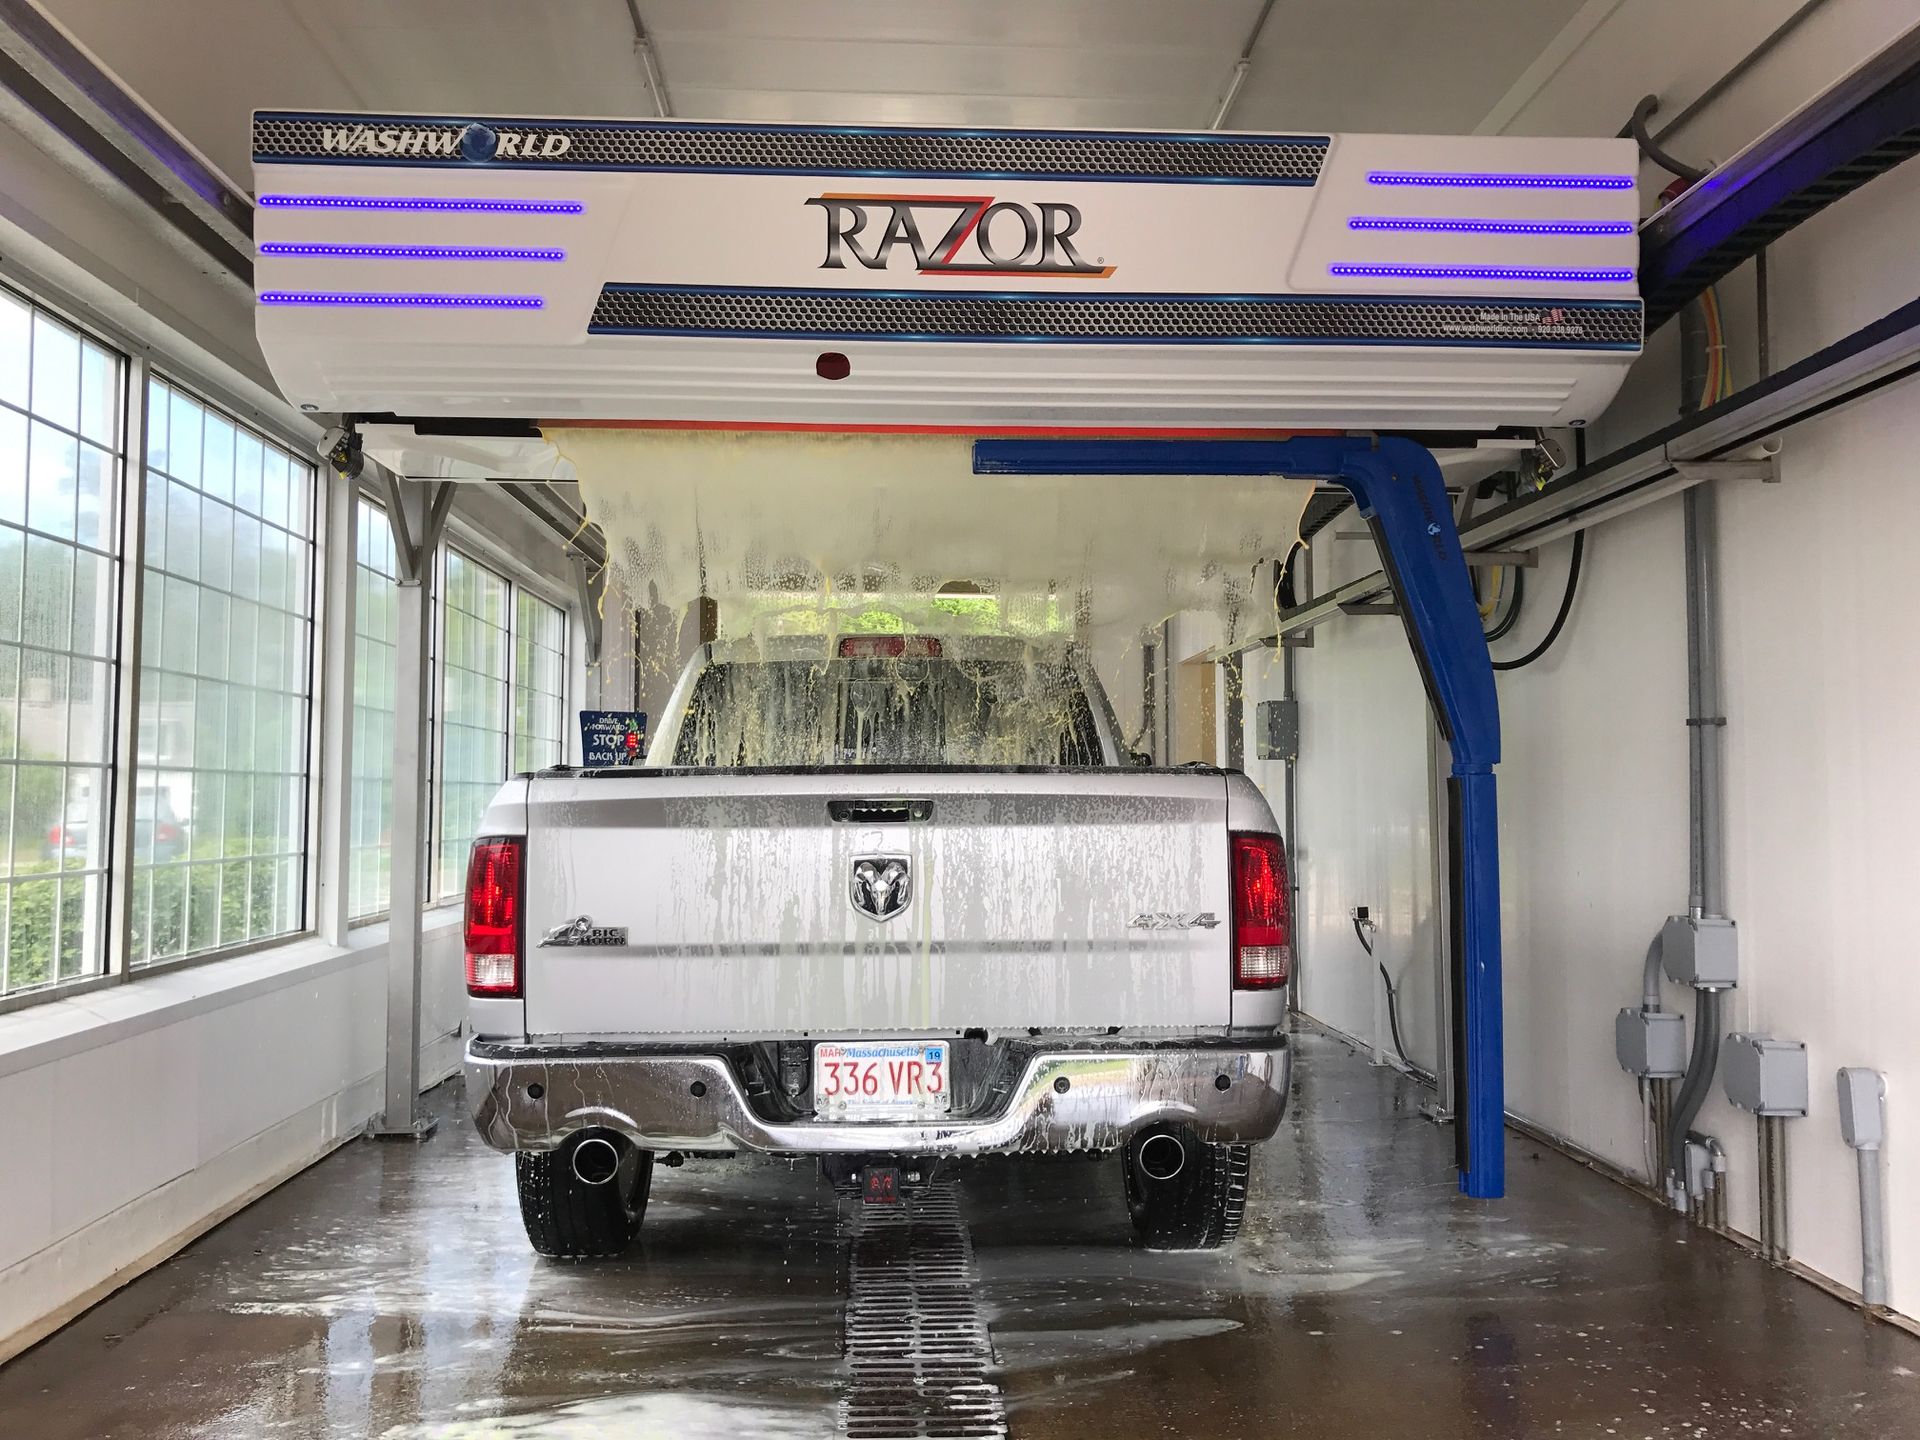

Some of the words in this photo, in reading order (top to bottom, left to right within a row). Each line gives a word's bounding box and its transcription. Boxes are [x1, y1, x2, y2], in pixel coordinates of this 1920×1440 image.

[804, 195, 1108, 275] RAZOR
[1480, 312, 1500, 321] Made
[1501, 313, 1509, 321] In
[1510, 313, 1523, 321] The
[1525, 313, 1541, 322] USA
[1443, 324, 1528, 333] www.washworldinc.com
[593, 734, 625, 746] STOP
[589, 752, 613, 761] BACK
[615, 752, 627, 761] UP
[820, 1048, 841, 1058] MAR
[846, 1047, 919, 1058] Massachusetts
[928, 1051, 941, 1060] 19
[824, 1062, 878, 1096] 336
[888, 1061, 943, 1095] VR3
